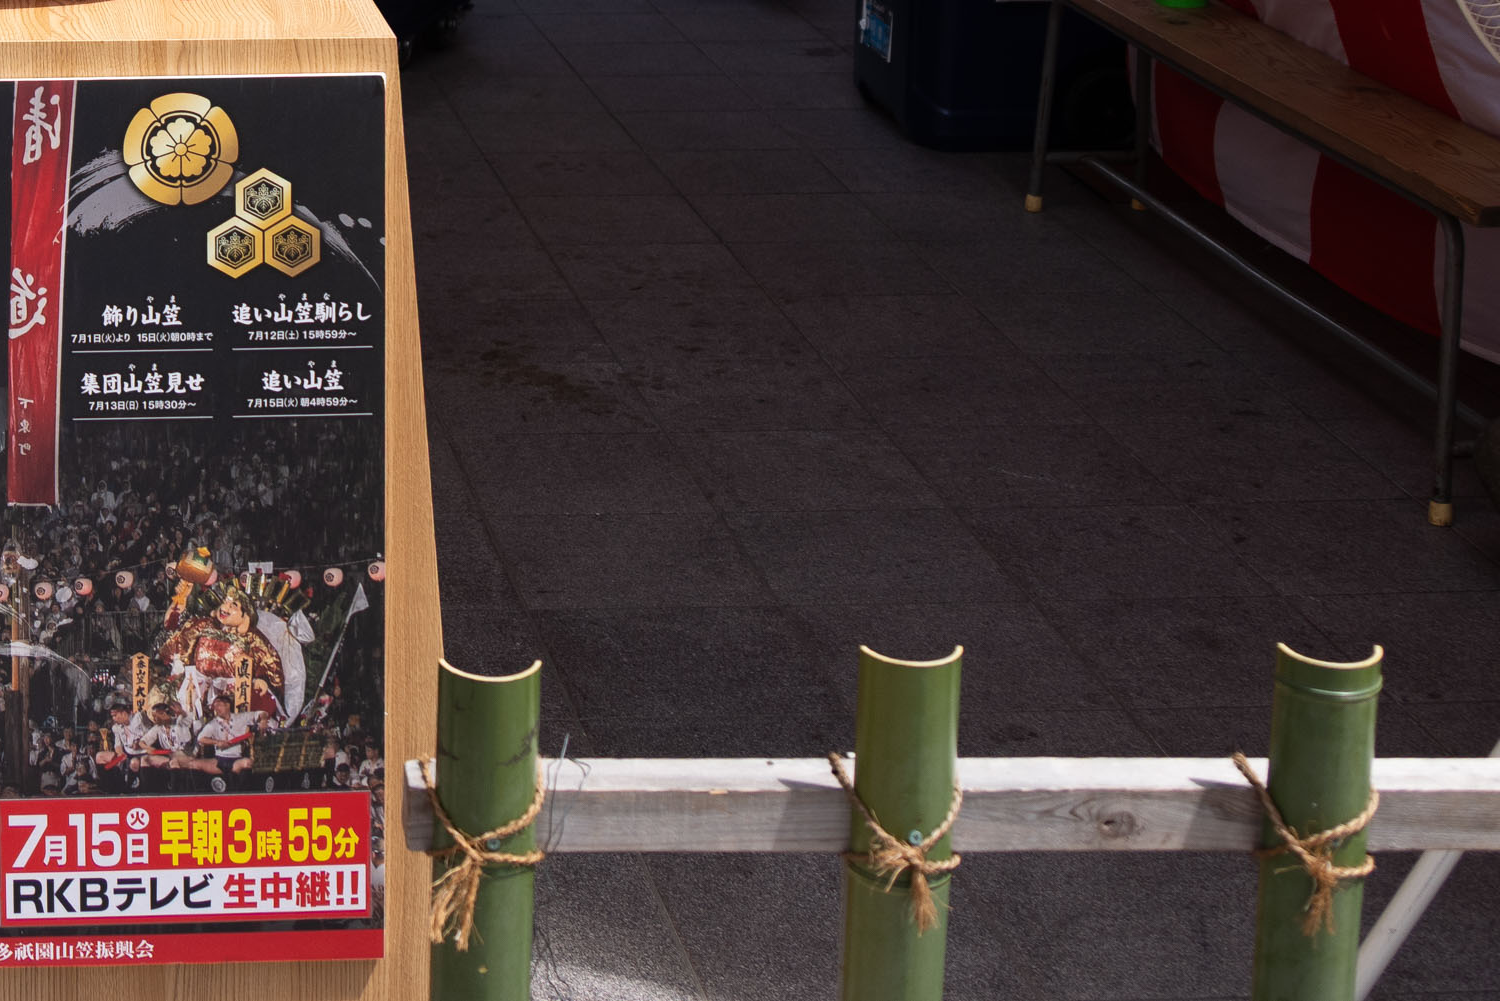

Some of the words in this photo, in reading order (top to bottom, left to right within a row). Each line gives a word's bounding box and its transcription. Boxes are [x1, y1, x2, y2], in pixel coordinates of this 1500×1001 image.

[101, 304, 182, 327] 飾り山笠
[231, 301, 372, 325] 追い山笠馴らし
[71, 333, 131, 344] 7月1日(火)より
[137, 331, 214, 343] 15日(火)朝0時まで
[248, 331, 299, 341] 7月12日(土)
[80, 371, 205, 395] 集団山笠見せ
[261, 369, 344, 392] 追い山笠
[88, 401, 139, 411] 7月13日(日)
[247, 398, 298, 409] 7月15日(火)
[13, 873, 214, 914] RKBテレビ
